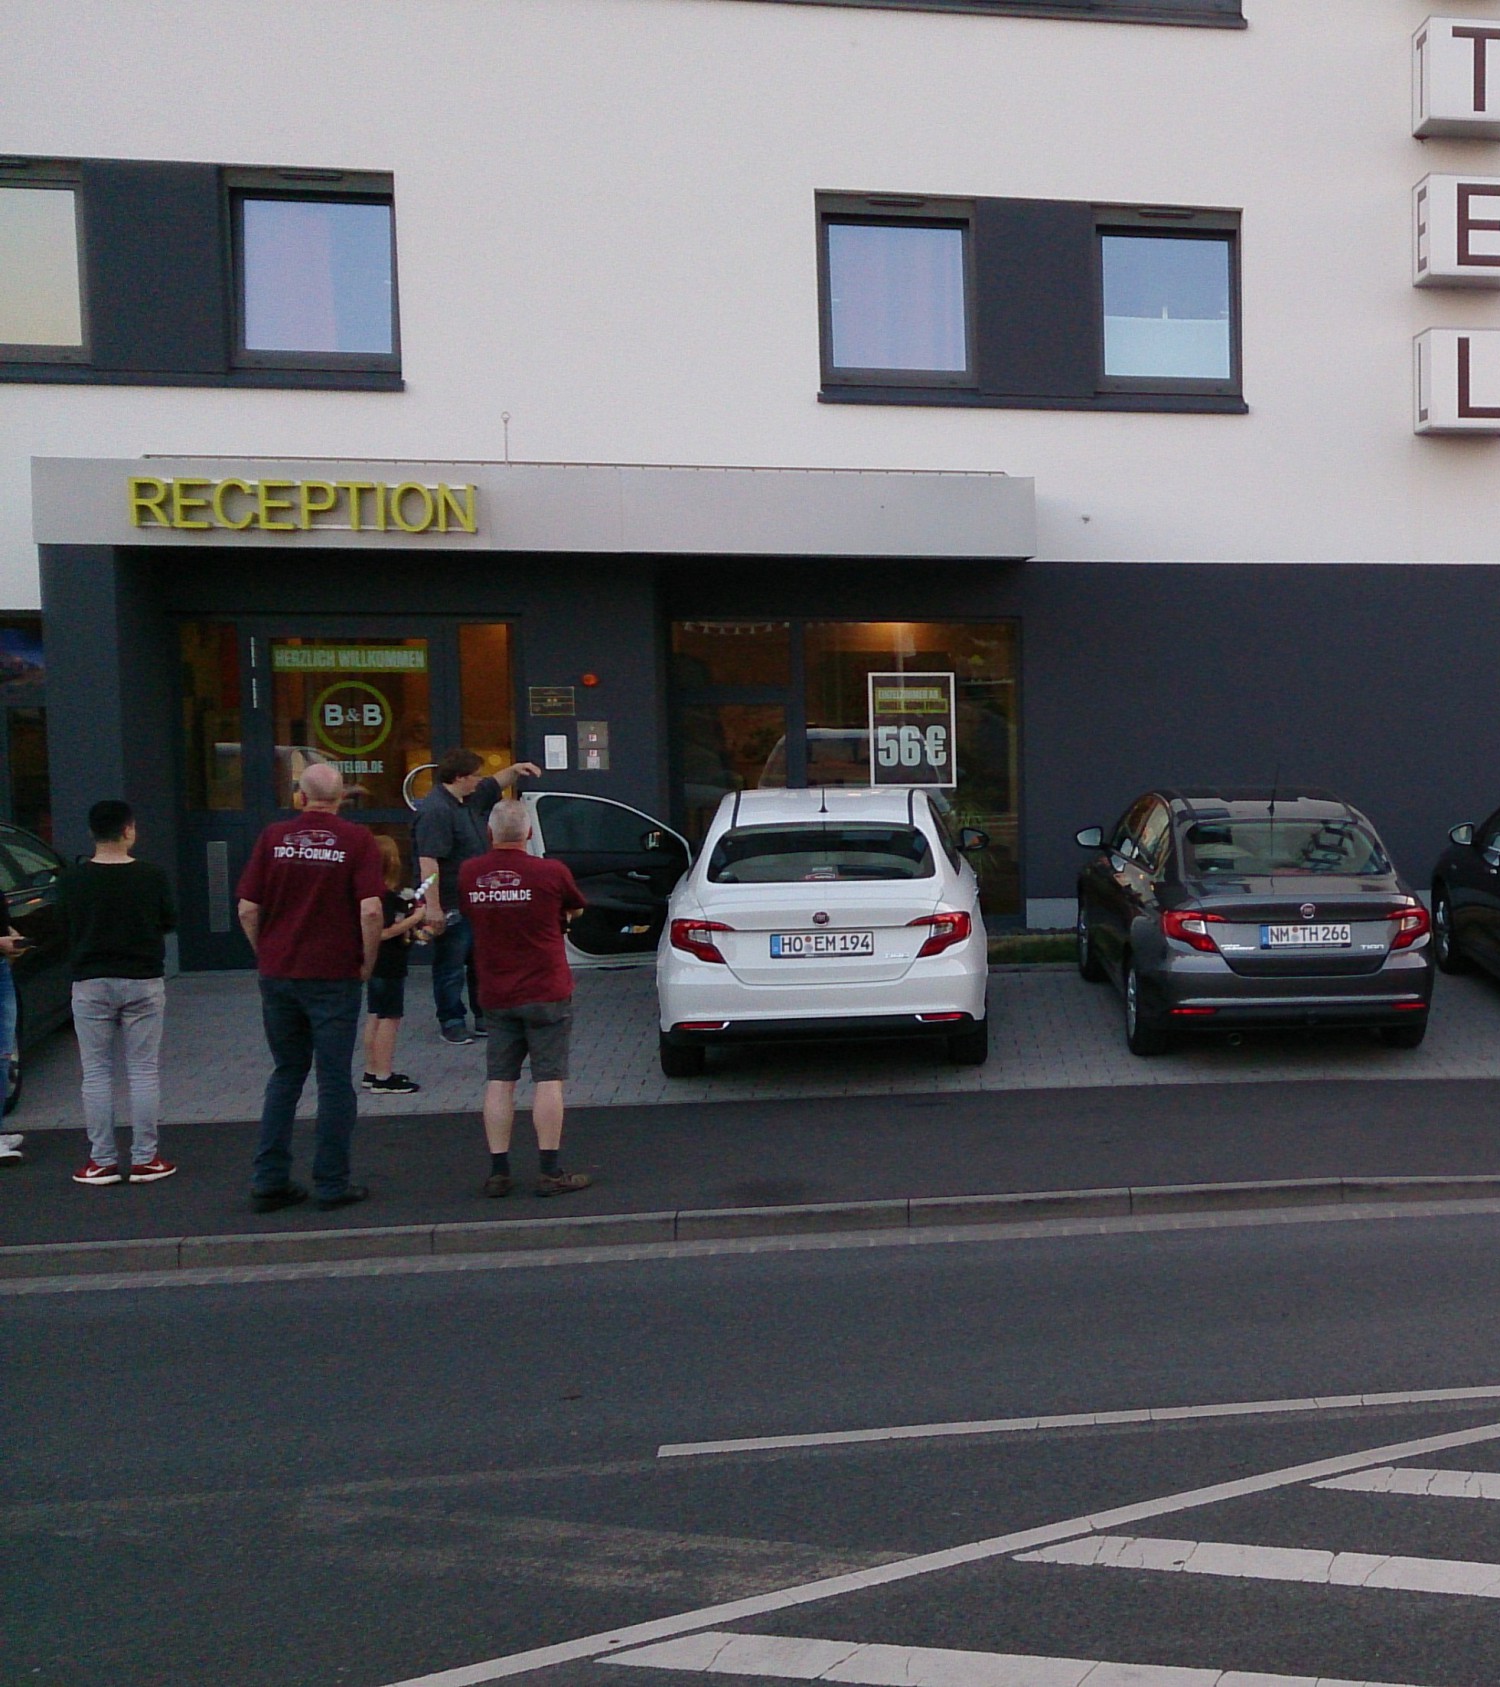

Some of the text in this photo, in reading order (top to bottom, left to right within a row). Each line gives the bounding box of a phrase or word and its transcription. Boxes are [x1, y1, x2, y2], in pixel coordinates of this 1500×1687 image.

[128, 477, 477, 533] RECEPTION
[274, 650, 425, 668] HERZLICH WILLKOMMEN
[324, 703, 383, 727] B&B
[273, 847, 346, 862] TIPO-FORUM.DE
[469, 889, 532, 903] TIPO-FORUM.DE
[781, 934, 871, 953] HO EM 194
[1270, 926, 1349, 943] NM TH 266
